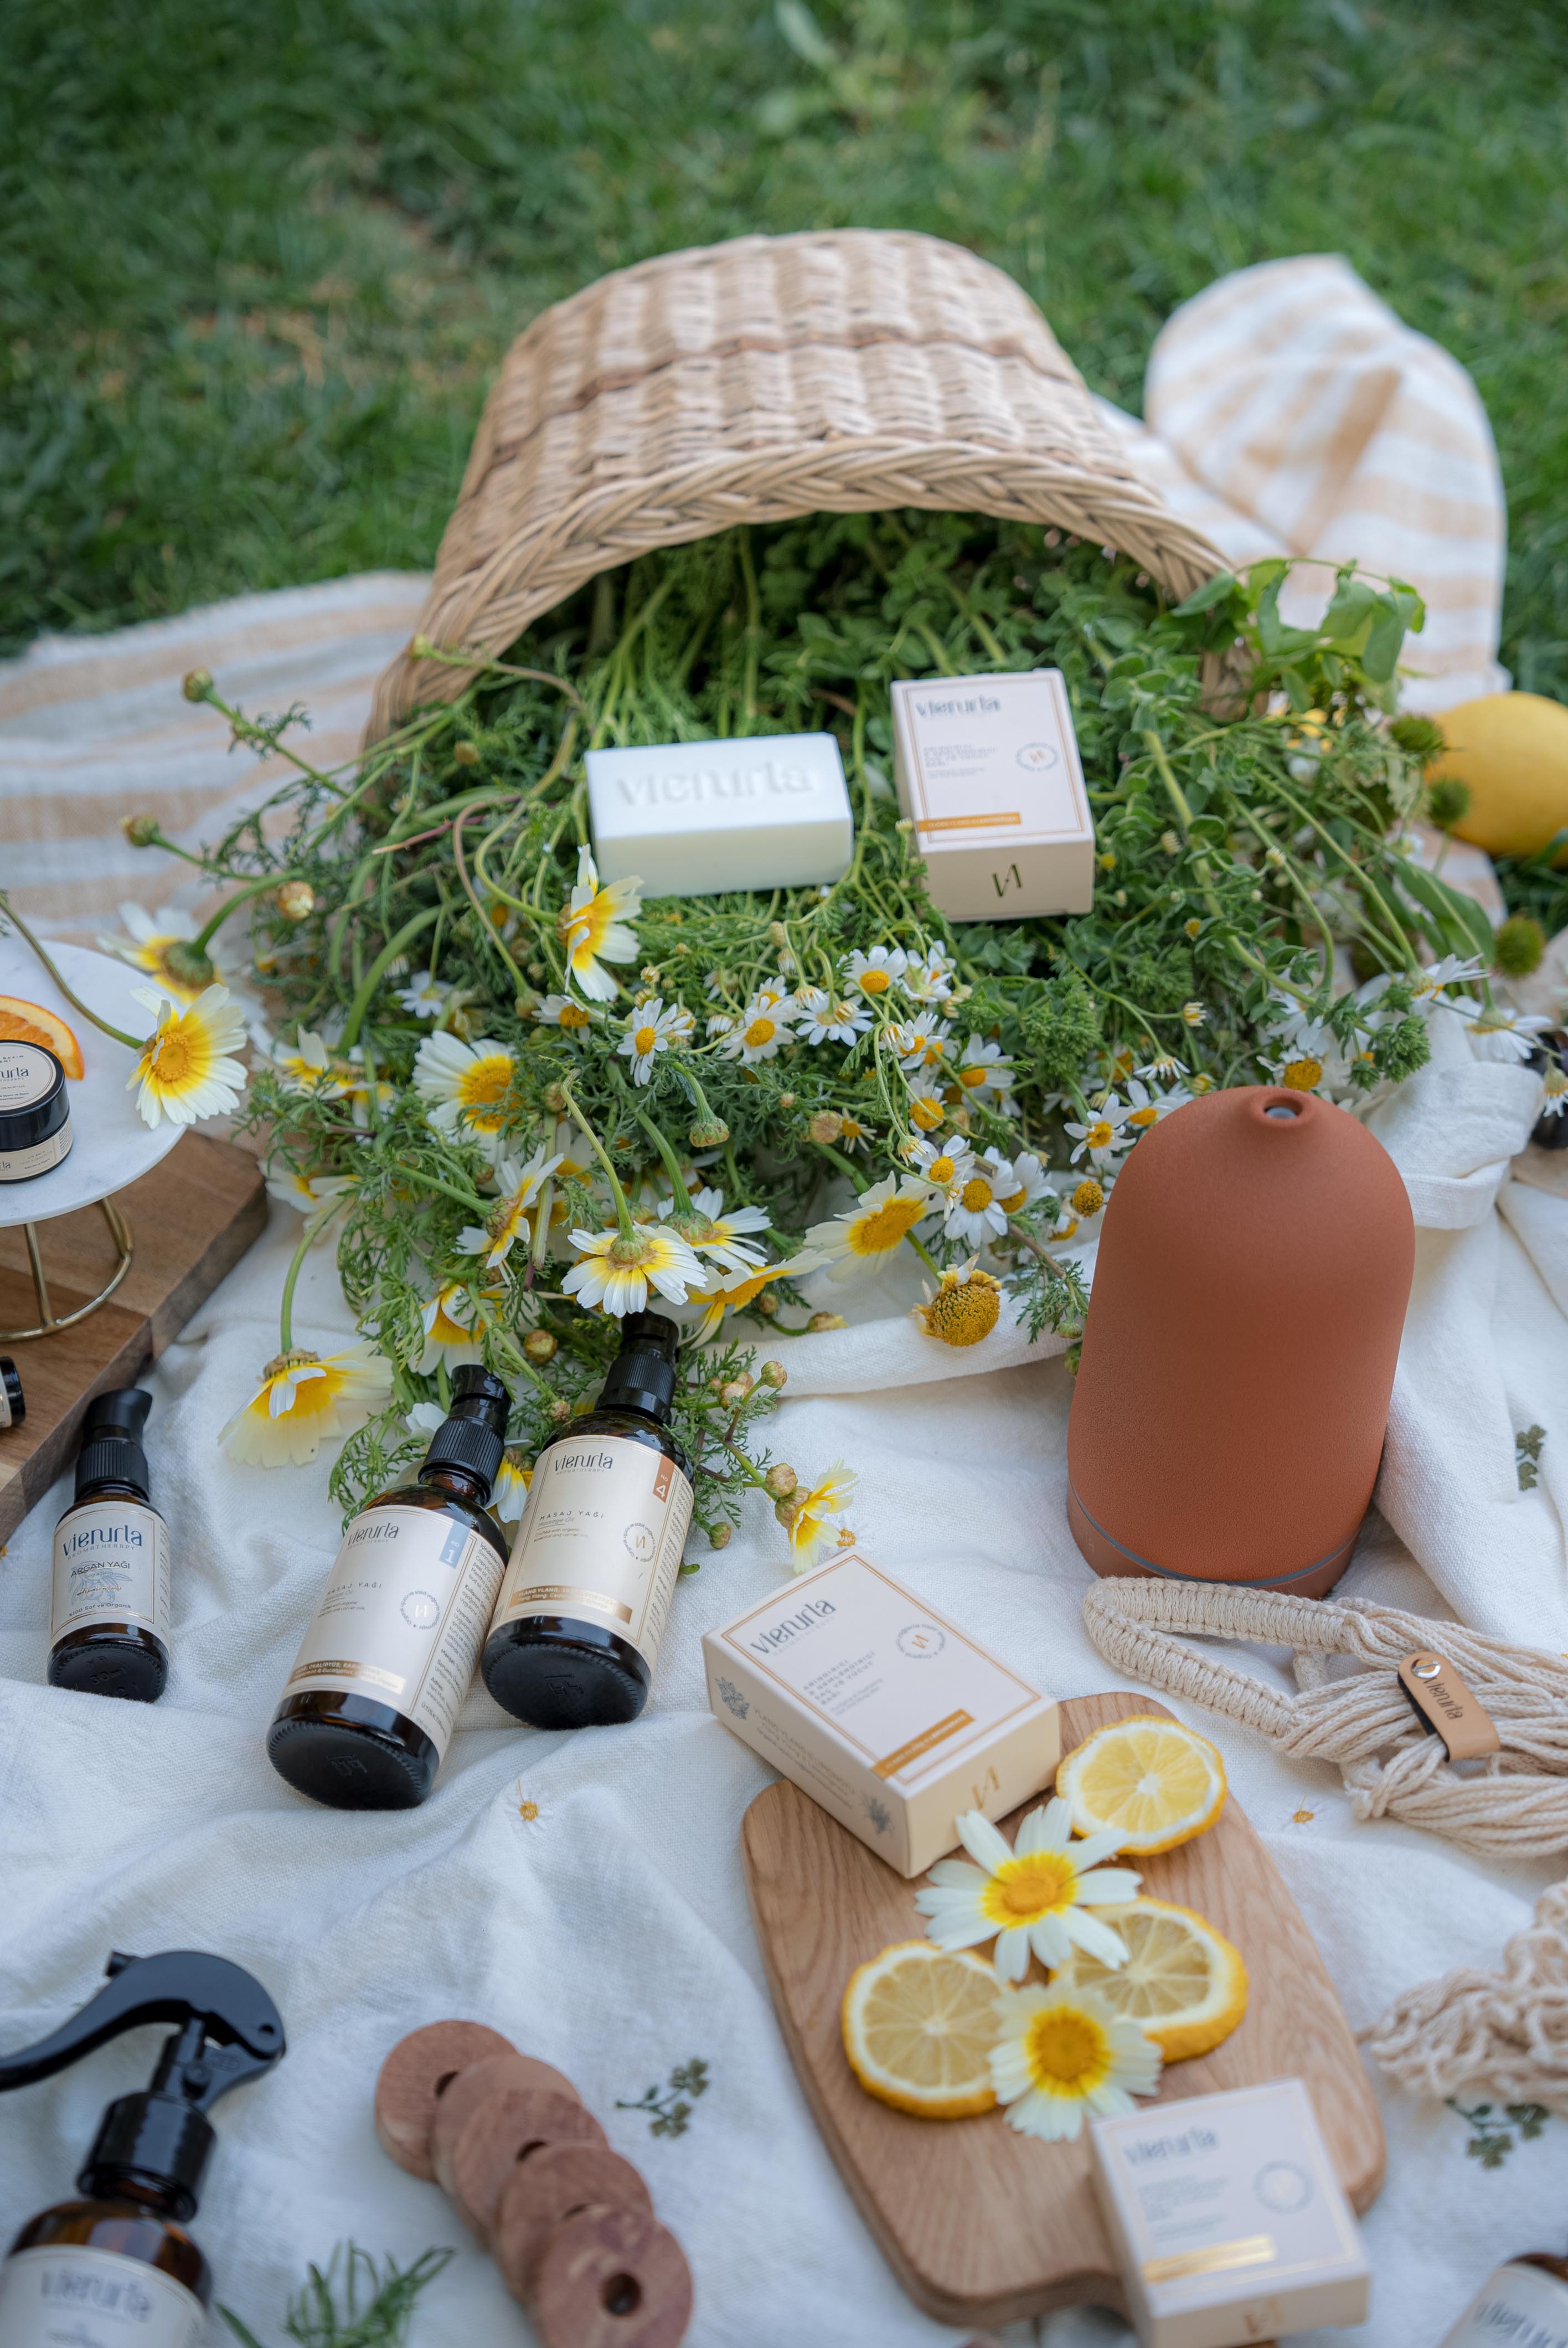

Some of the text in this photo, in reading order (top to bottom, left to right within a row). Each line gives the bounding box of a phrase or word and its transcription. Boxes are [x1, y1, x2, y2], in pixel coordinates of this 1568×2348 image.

[555, 1453, 613, 1471] vienurla
[656, 1485, 666, 1498] 4
[540, 1511, 604, 1521] MASAJ YAĞI
[63, 1525, 142, 1557] vienurla
[348, 1522, 399, 1547] vienurla
[68, 1543, 135, 1560] AROMATHERAPY
[445, 1549, 455, 1563] 1
[71, 1562, 105, 1578] ARGAN
[107, 1561, 130, 1569] YAĞI
[750, 1600, 837, 1654] vienurla
